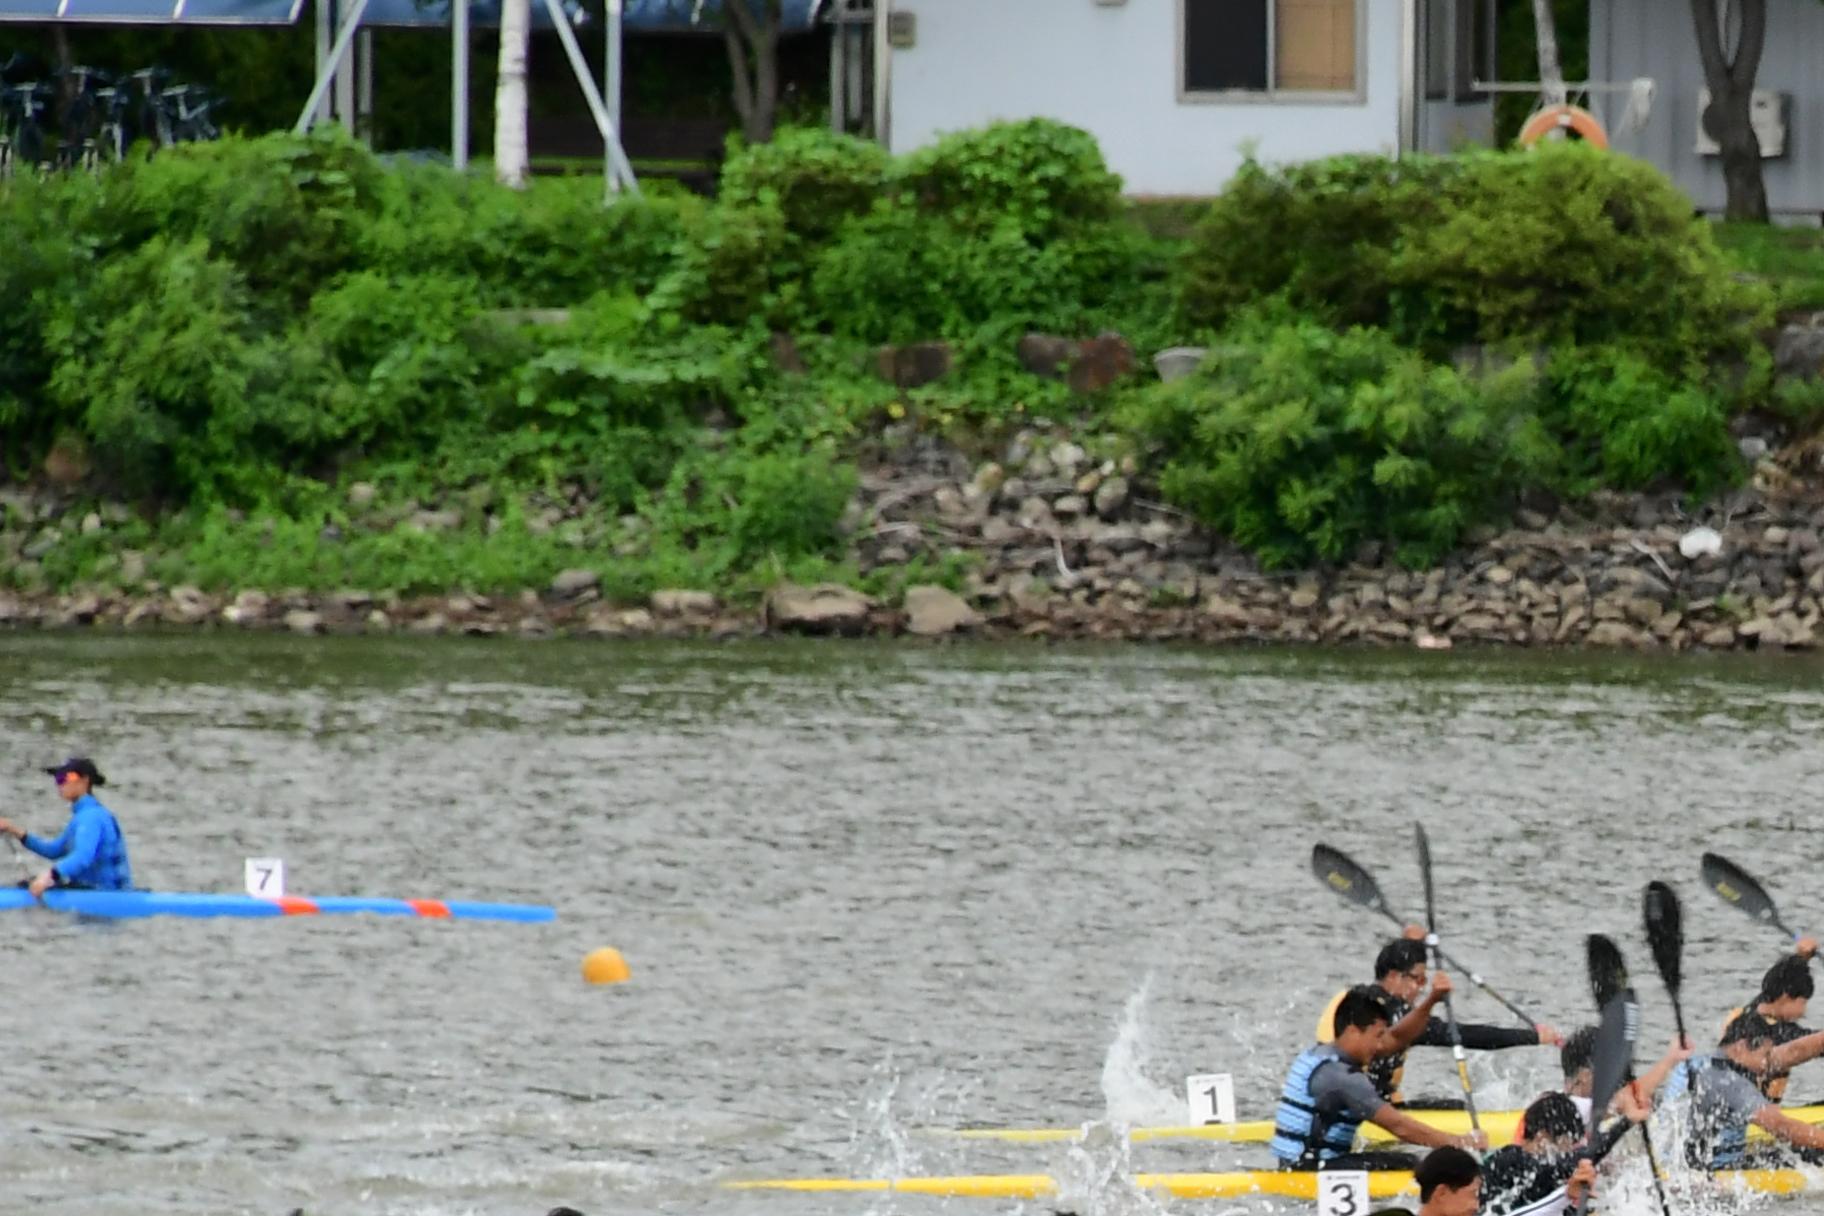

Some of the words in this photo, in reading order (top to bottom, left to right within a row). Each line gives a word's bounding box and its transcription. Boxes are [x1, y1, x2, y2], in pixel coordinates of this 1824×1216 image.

[255, 868, 273, 891] 7
[1203, 1086, 1219, 1116] 1
[1331, 1183, 1357, 1216] 3
